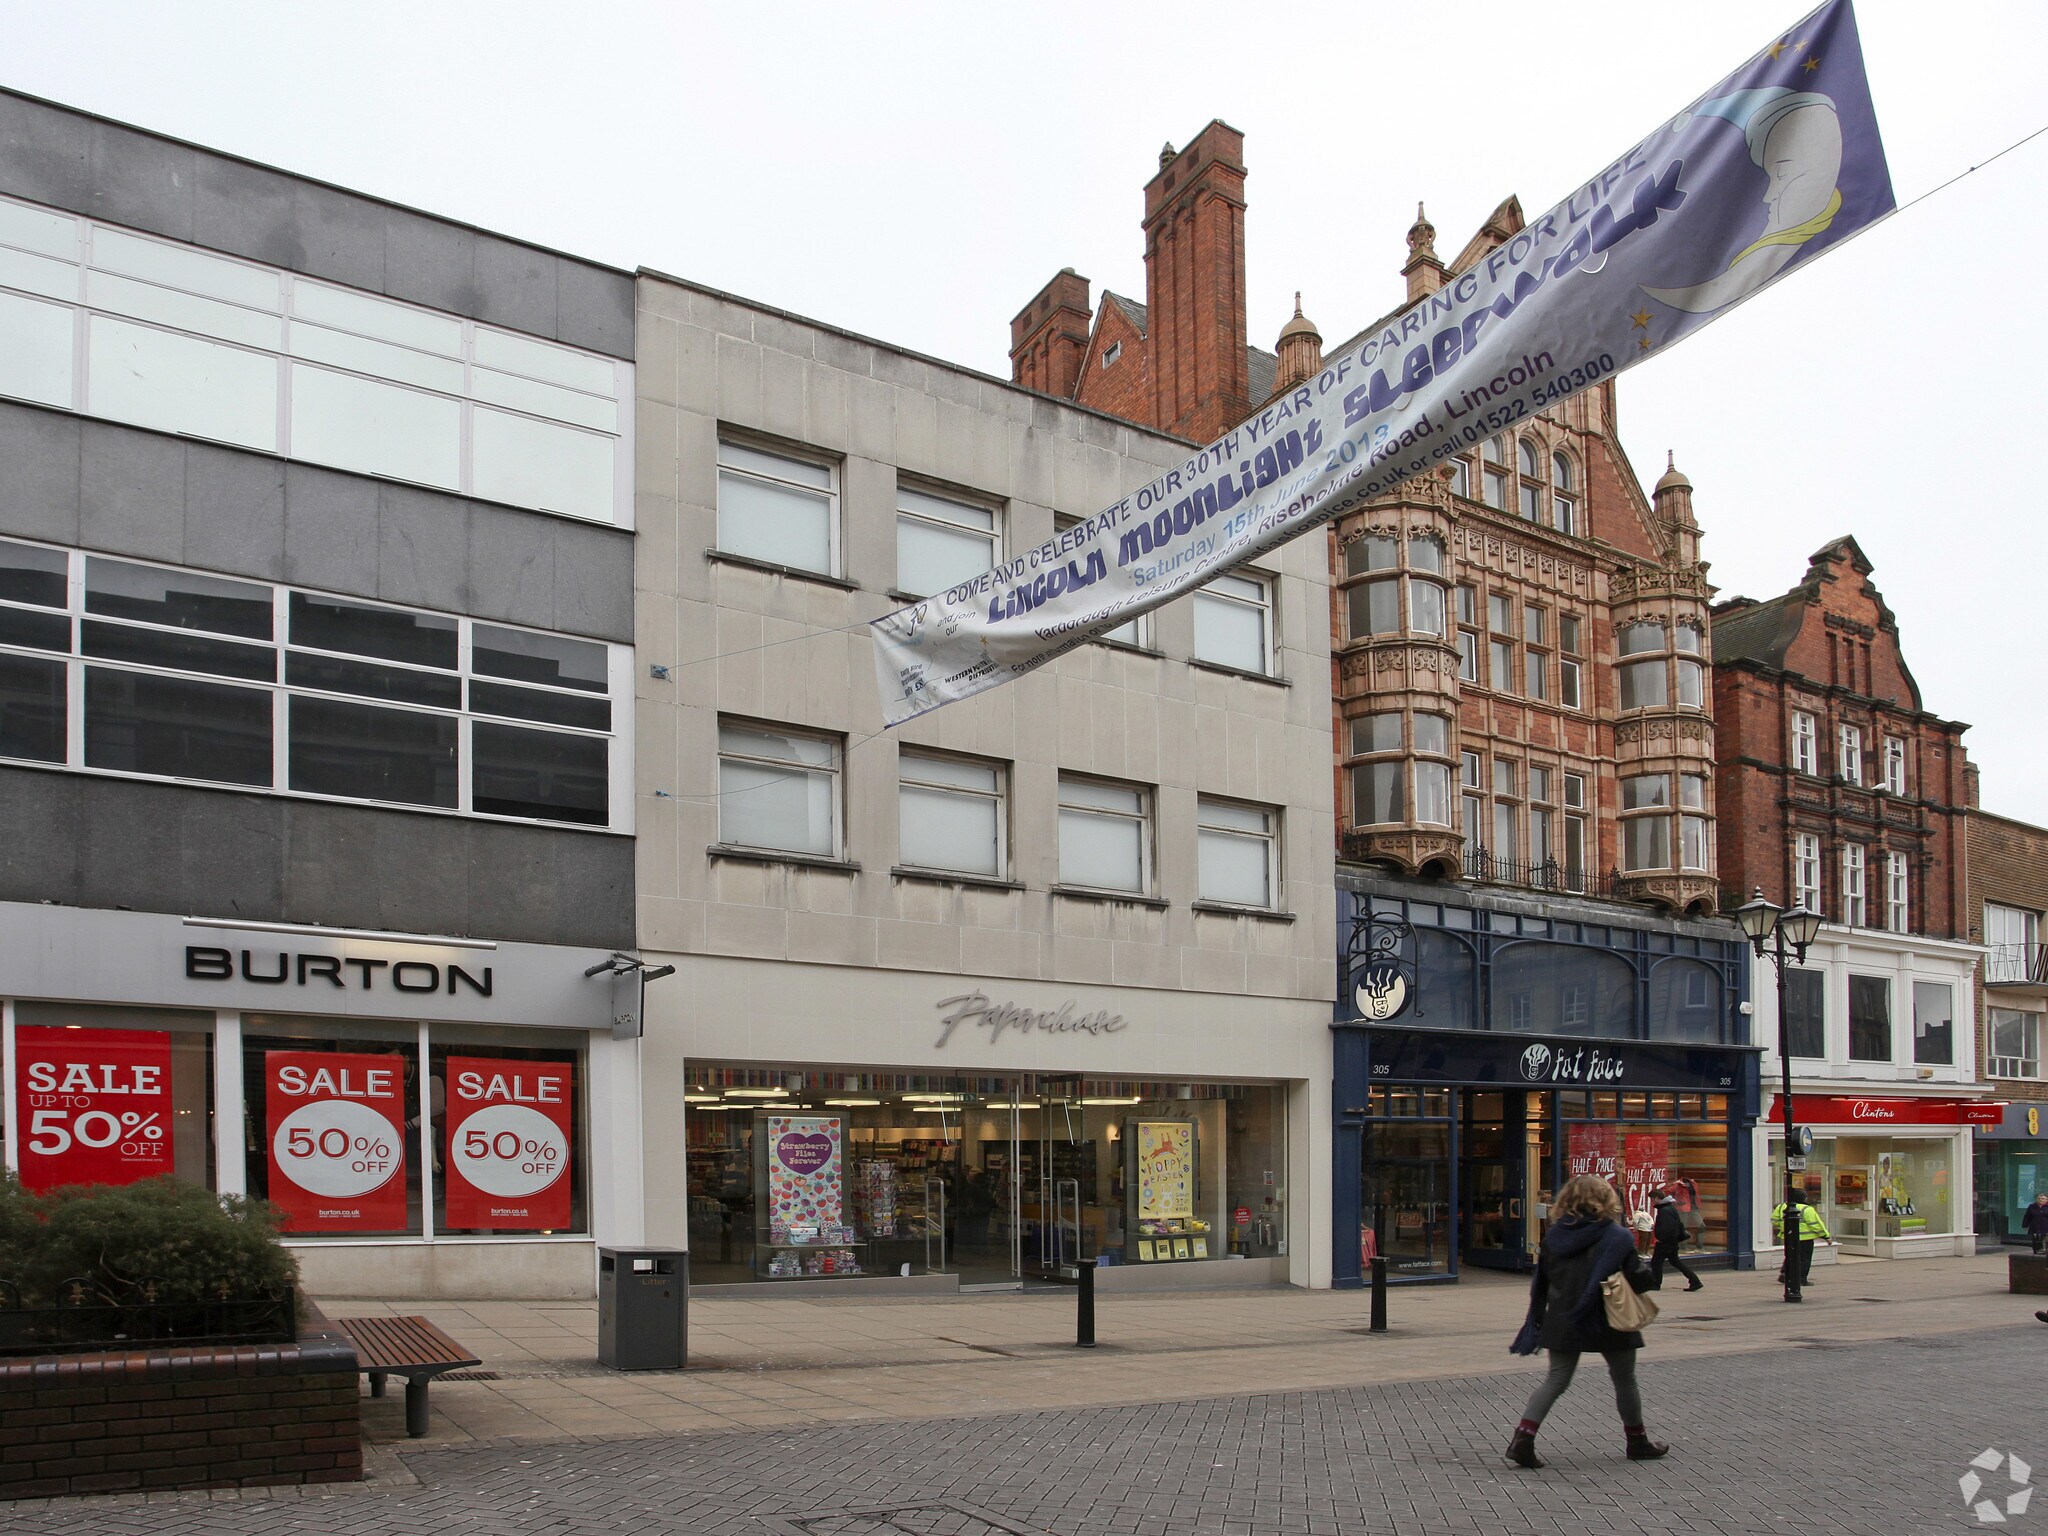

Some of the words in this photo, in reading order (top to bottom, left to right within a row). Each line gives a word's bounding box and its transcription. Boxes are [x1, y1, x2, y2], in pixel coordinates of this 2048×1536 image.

[946, 574, 990, 606] COME
[991, 557, 1025, 586] AND
[1030, 499, 1130, 569] CELEBRATE
[1137, 470, 1183, 511] OUR
[1187, 431, 1240, 482] 30TH
[1246, 388, 1313, 445] YEAR
[1318, 357, 1352, 396] OF
[1360, 273, 1478, 368] CARING
[1486, 214, 1558, 284] FOR
[1567, 143, 1647, 224] LIFE
[1411, 457, 1430, 471] or
[1432, 437, 1461, 460] call
[1462, 399, 1529, 443] 01522
[1533, 353, 1616, 407] 540300
[1035, 601, 1123, 641] Yarborough
[1126, 572, 1190, 605] Leisure
[1194, 534, 1252, 574] Centre,
[1258, 459, 1363, 535] Riseholme
[1369, 414, 1445, 468] Road,
[1444, 350, 1555, 420] Lincoln
[1133, 532, 1217, 588] Saturday
[1223, 503, 1265, 539] 15th
[1270, 466, 1318, 509] June
[1324, 423, 1391, 473] 2013
[953, 610, 977, 624] join
[945, 622, 959, 637] our
[944, 667, 973, 683] WESTERN
[185, 945, 493, 997] BURTON
[935, 988, 1129, 1048] Paperchase
[1373, 1065, 1390, 1075] 305
[28, 1062, 161, 1095] SALE
[277, 1066, 394, 1098] SALE
[1719, 1077, 1731, 1086] 305
[457, 1072, 562, 1103] SALE
[30, 1095, 57, 1107] UP
[61, 1095, 91, 1108] TO
[1852, 1101, 1895, 1118] Clintons
[29, 1110, 163, 1155] 50%
[120, 1142, 163, 1156] OFF
[287, 1127, 392, 1160] 50%
[464, 1130, 558, 1161] 50%
[780, 1142, 831, 1151] Strawberry
[351, 1160, 389, 1173] OFF
[521, 1162, 556, 1174] OFF
[789, 1157, 822, 1165] Forever
[1572, 1158, 1591, 1173] HALF
[1595, 1157, 1616, 1173] PRICE
[1627, 1169, 1645, 1183] HALF
[1648, 1168, 1666, 1183] PRICE
[1398, 1260, 1443, 1268] www.fatface.com
